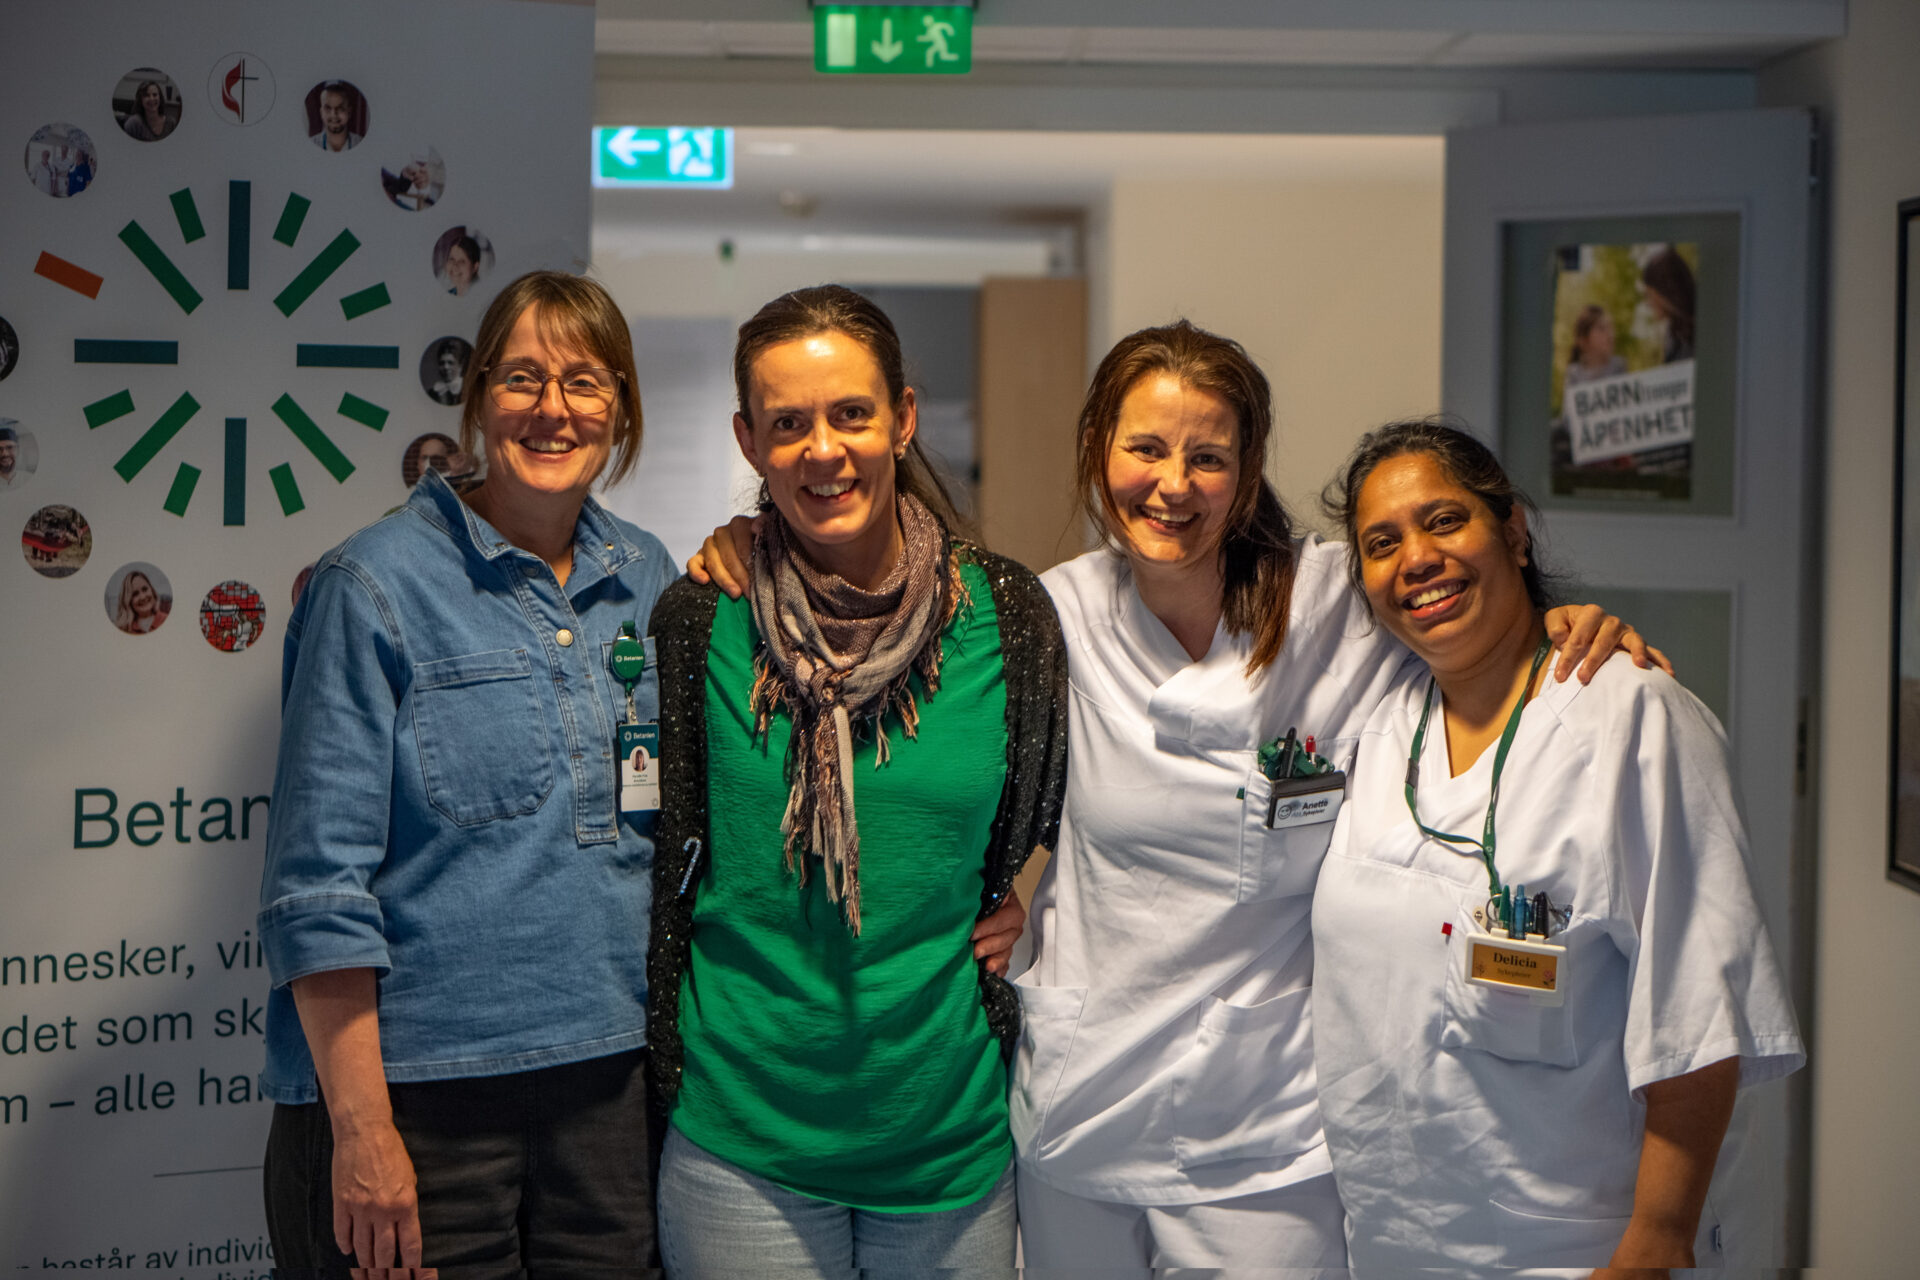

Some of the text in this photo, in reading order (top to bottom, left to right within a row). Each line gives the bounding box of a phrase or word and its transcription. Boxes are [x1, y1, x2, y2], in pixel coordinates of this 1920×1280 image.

[1574, 379, 1641, 416] BARN
[1580, 404, 1691, 449] ÅPENHET
[633, 732, 655, 740] Betanien
[1302, 799, 1329, 810] Anette
[2, 939, 195, 985] nnesker,
[1493, 952, 1537, 968] Delicia
[2, 998, 266, 1055] det som sk
[94, 1073, 176, 1115] alle
